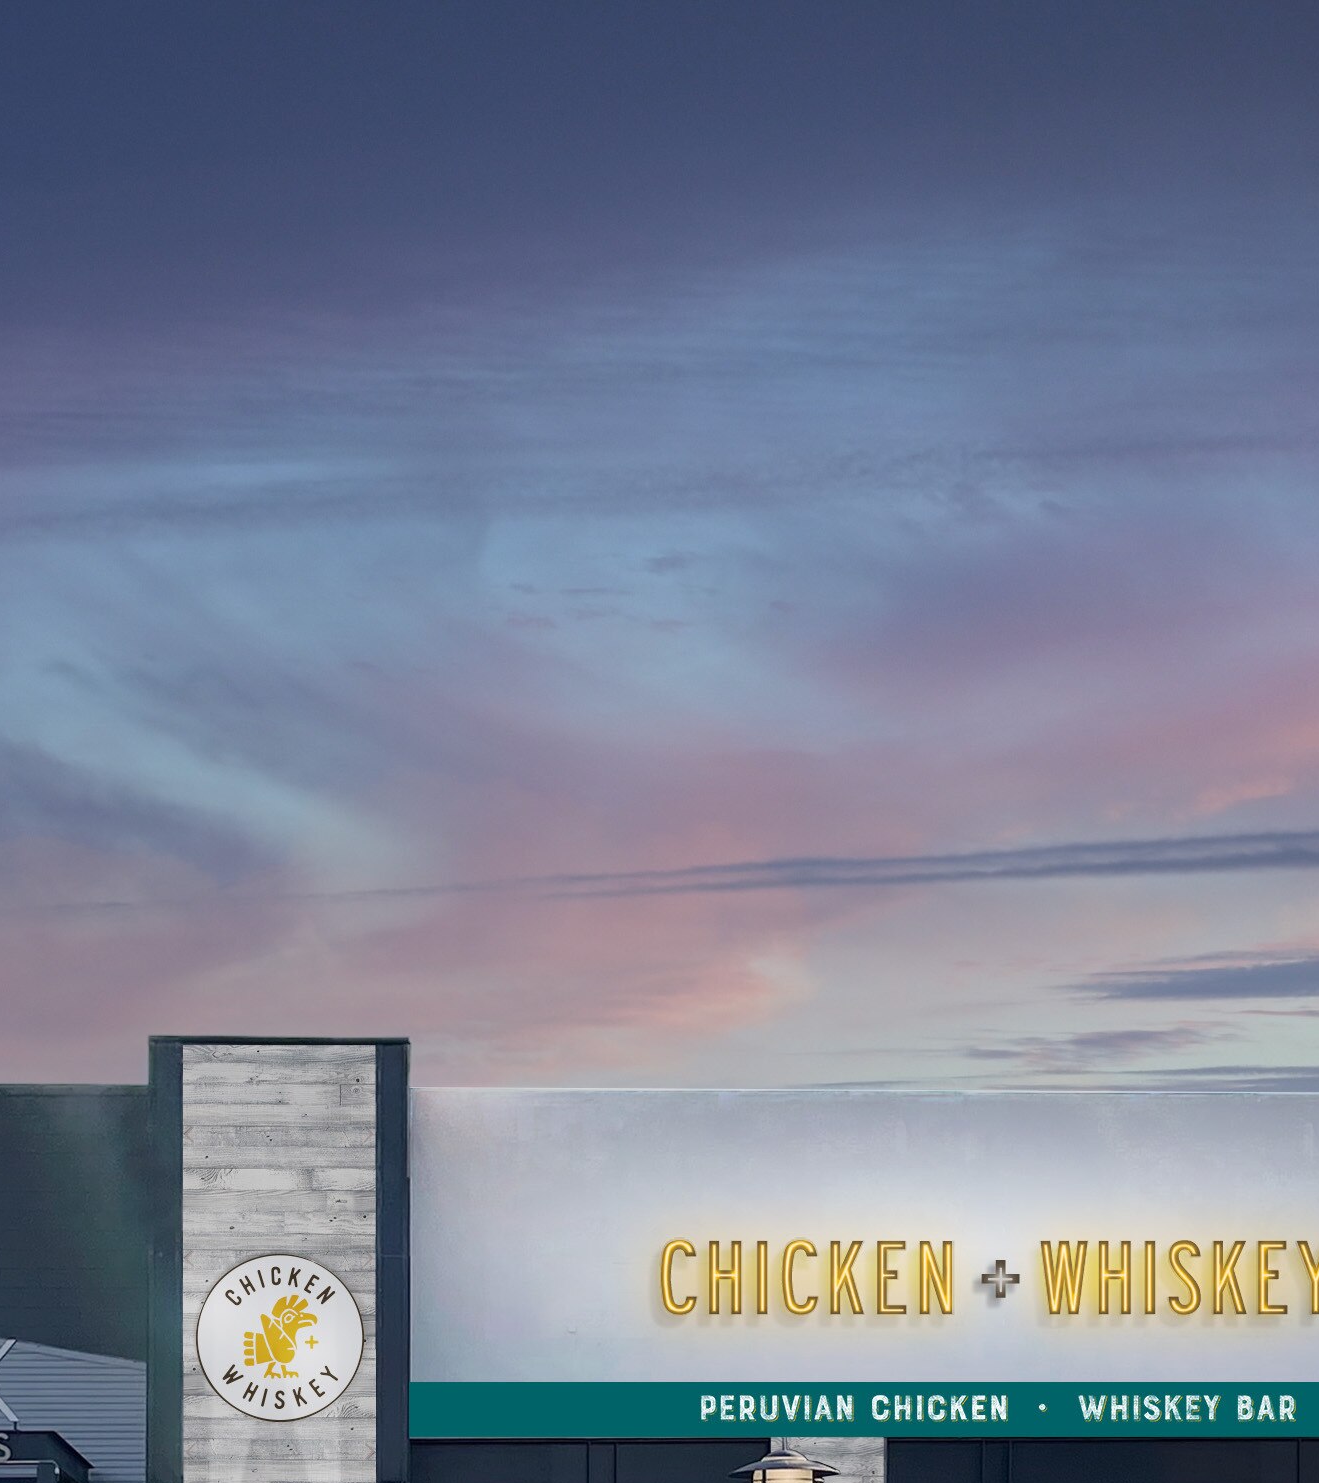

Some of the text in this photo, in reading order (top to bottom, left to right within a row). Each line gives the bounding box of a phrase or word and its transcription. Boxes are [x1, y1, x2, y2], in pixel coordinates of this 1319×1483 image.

[225, 1266, 335, 1306] CHICKEN
[659, 1238, 956, 1316] CHICKEN
[222, 1364, 339, 1410] WHISKEY
[699, 1394, 1298, 1423] PERUVIAN CHICKEN WHISKEY BAR
